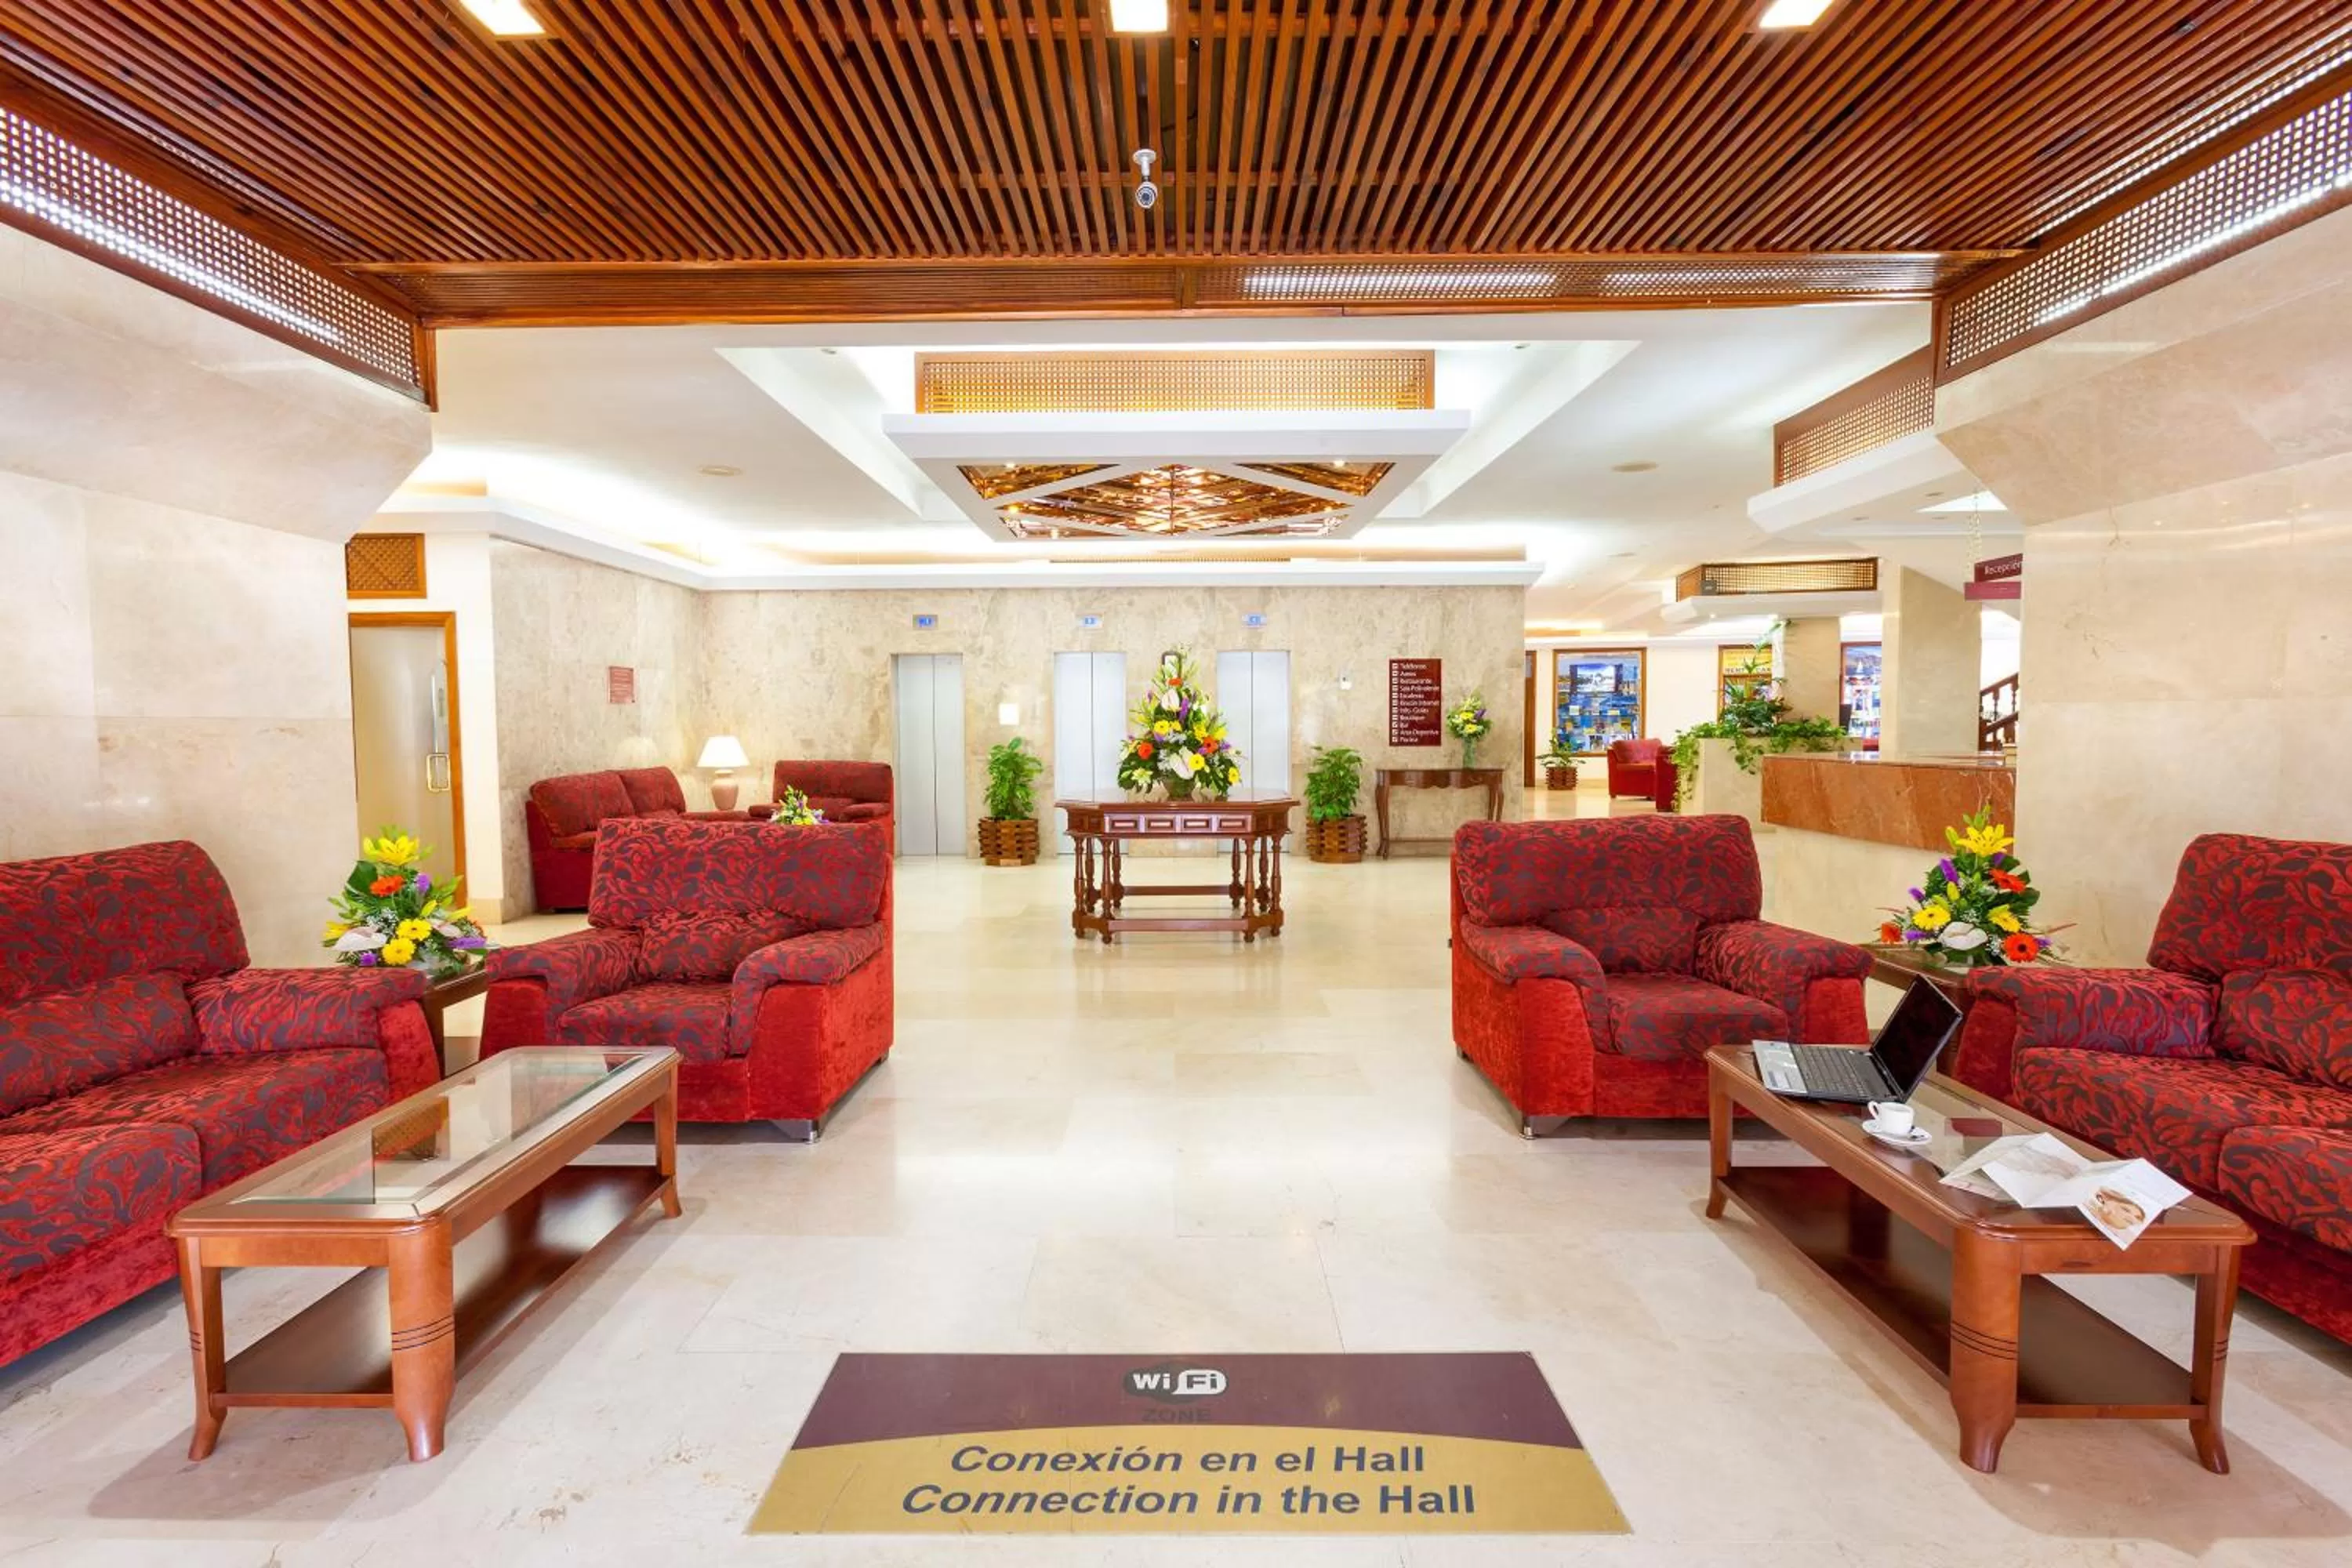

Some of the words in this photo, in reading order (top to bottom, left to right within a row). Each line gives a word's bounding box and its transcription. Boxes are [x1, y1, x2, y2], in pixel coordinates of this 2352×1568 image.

[1142, 1409, 1210, 1422] ZONE
[951, 1445, 1181, 1472] Conexión
[1200, 1452, 1257, 1472] en
[1275, 1446, 1315, 1472] el
[1334, 1446, 1424, 1472] Hall
[902, 1484, 1199, 1514] Connection
[1216, 1486, 1261, 1514] in
[1281, 1485, 1359, 1514] the
[1379, 1485, 1475, 1514] Hall
